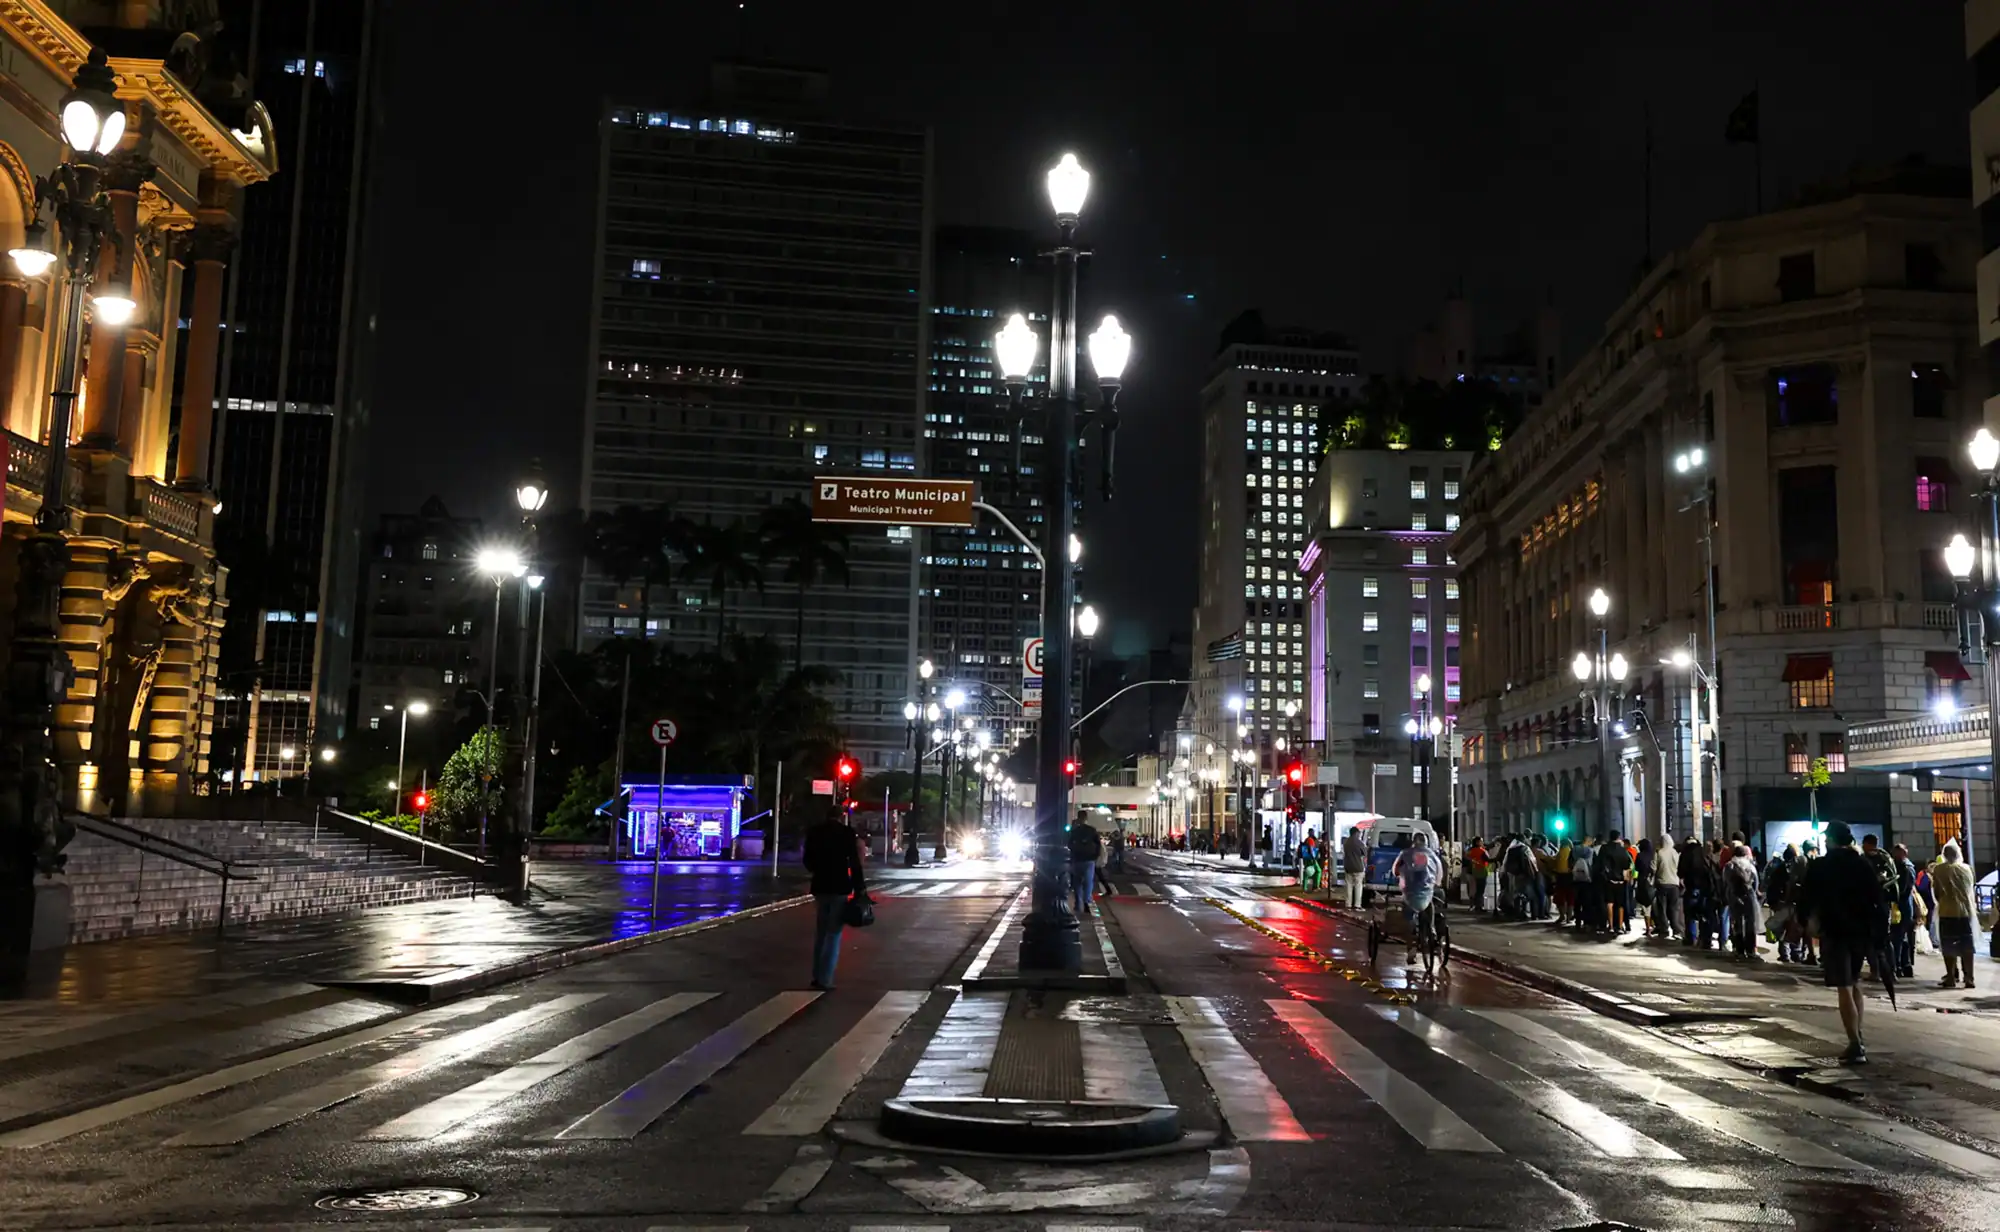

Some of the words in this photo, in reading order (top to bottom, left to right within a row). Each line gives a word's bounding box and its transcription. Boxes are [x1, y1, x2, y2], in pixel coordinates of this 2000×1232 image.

[844, 486, 890, 500] Teatro
[895, 487, 966, 503] Municipal
[849, 505, 893, 516] Municipal
[896, 507, 934, 516] Theater
